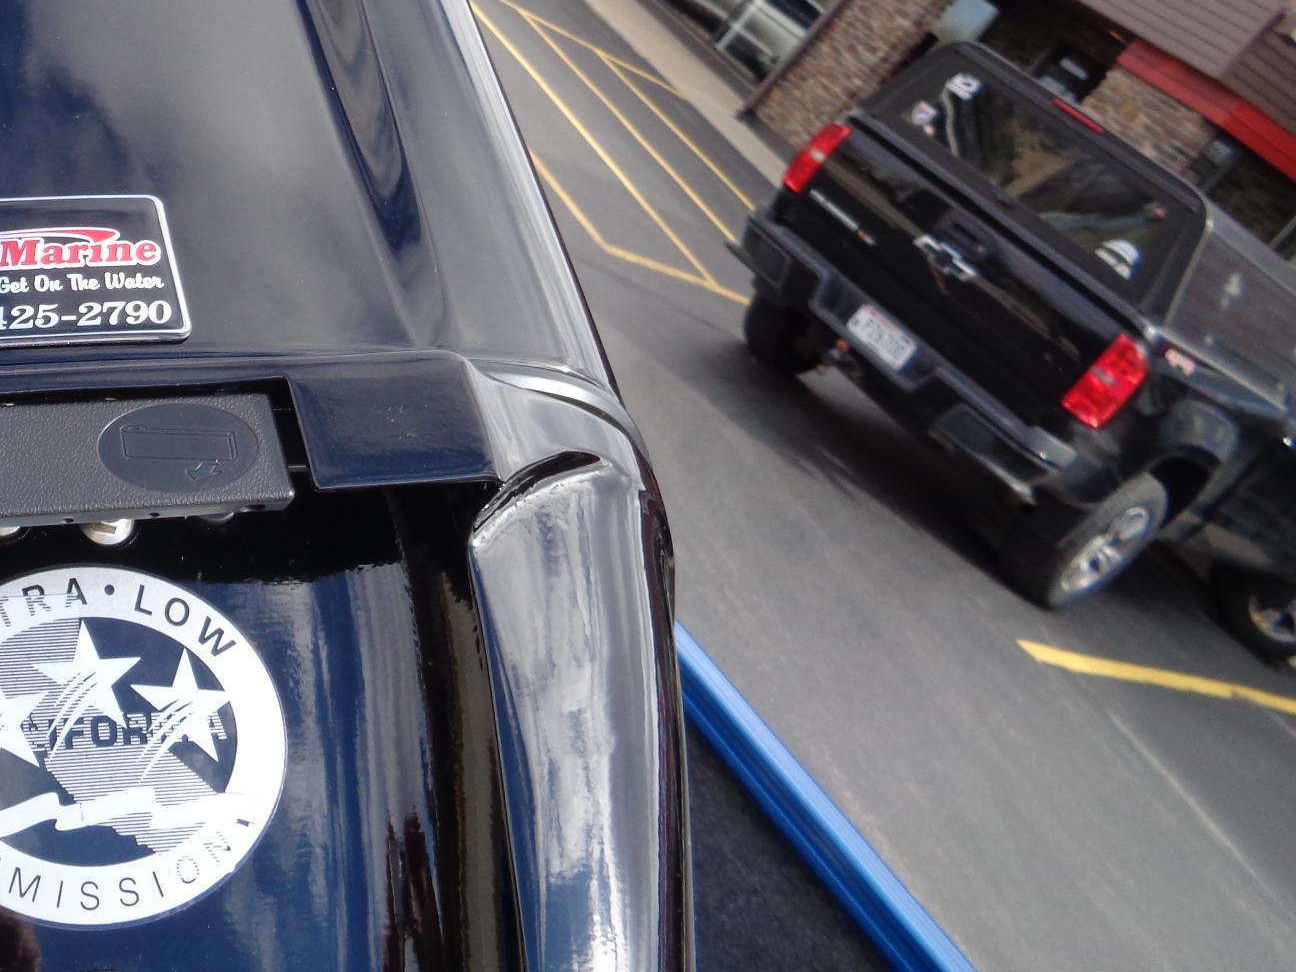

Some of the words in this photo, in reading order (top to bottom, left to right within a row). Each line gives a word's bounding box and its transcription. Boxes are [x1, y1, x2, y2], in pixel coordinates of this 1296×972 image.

[34, 274, 63, 292] On
[67, 273, 100, 291] The
[104, 271, 165, 290] Water
[134, 584, 237, 658] LOW
